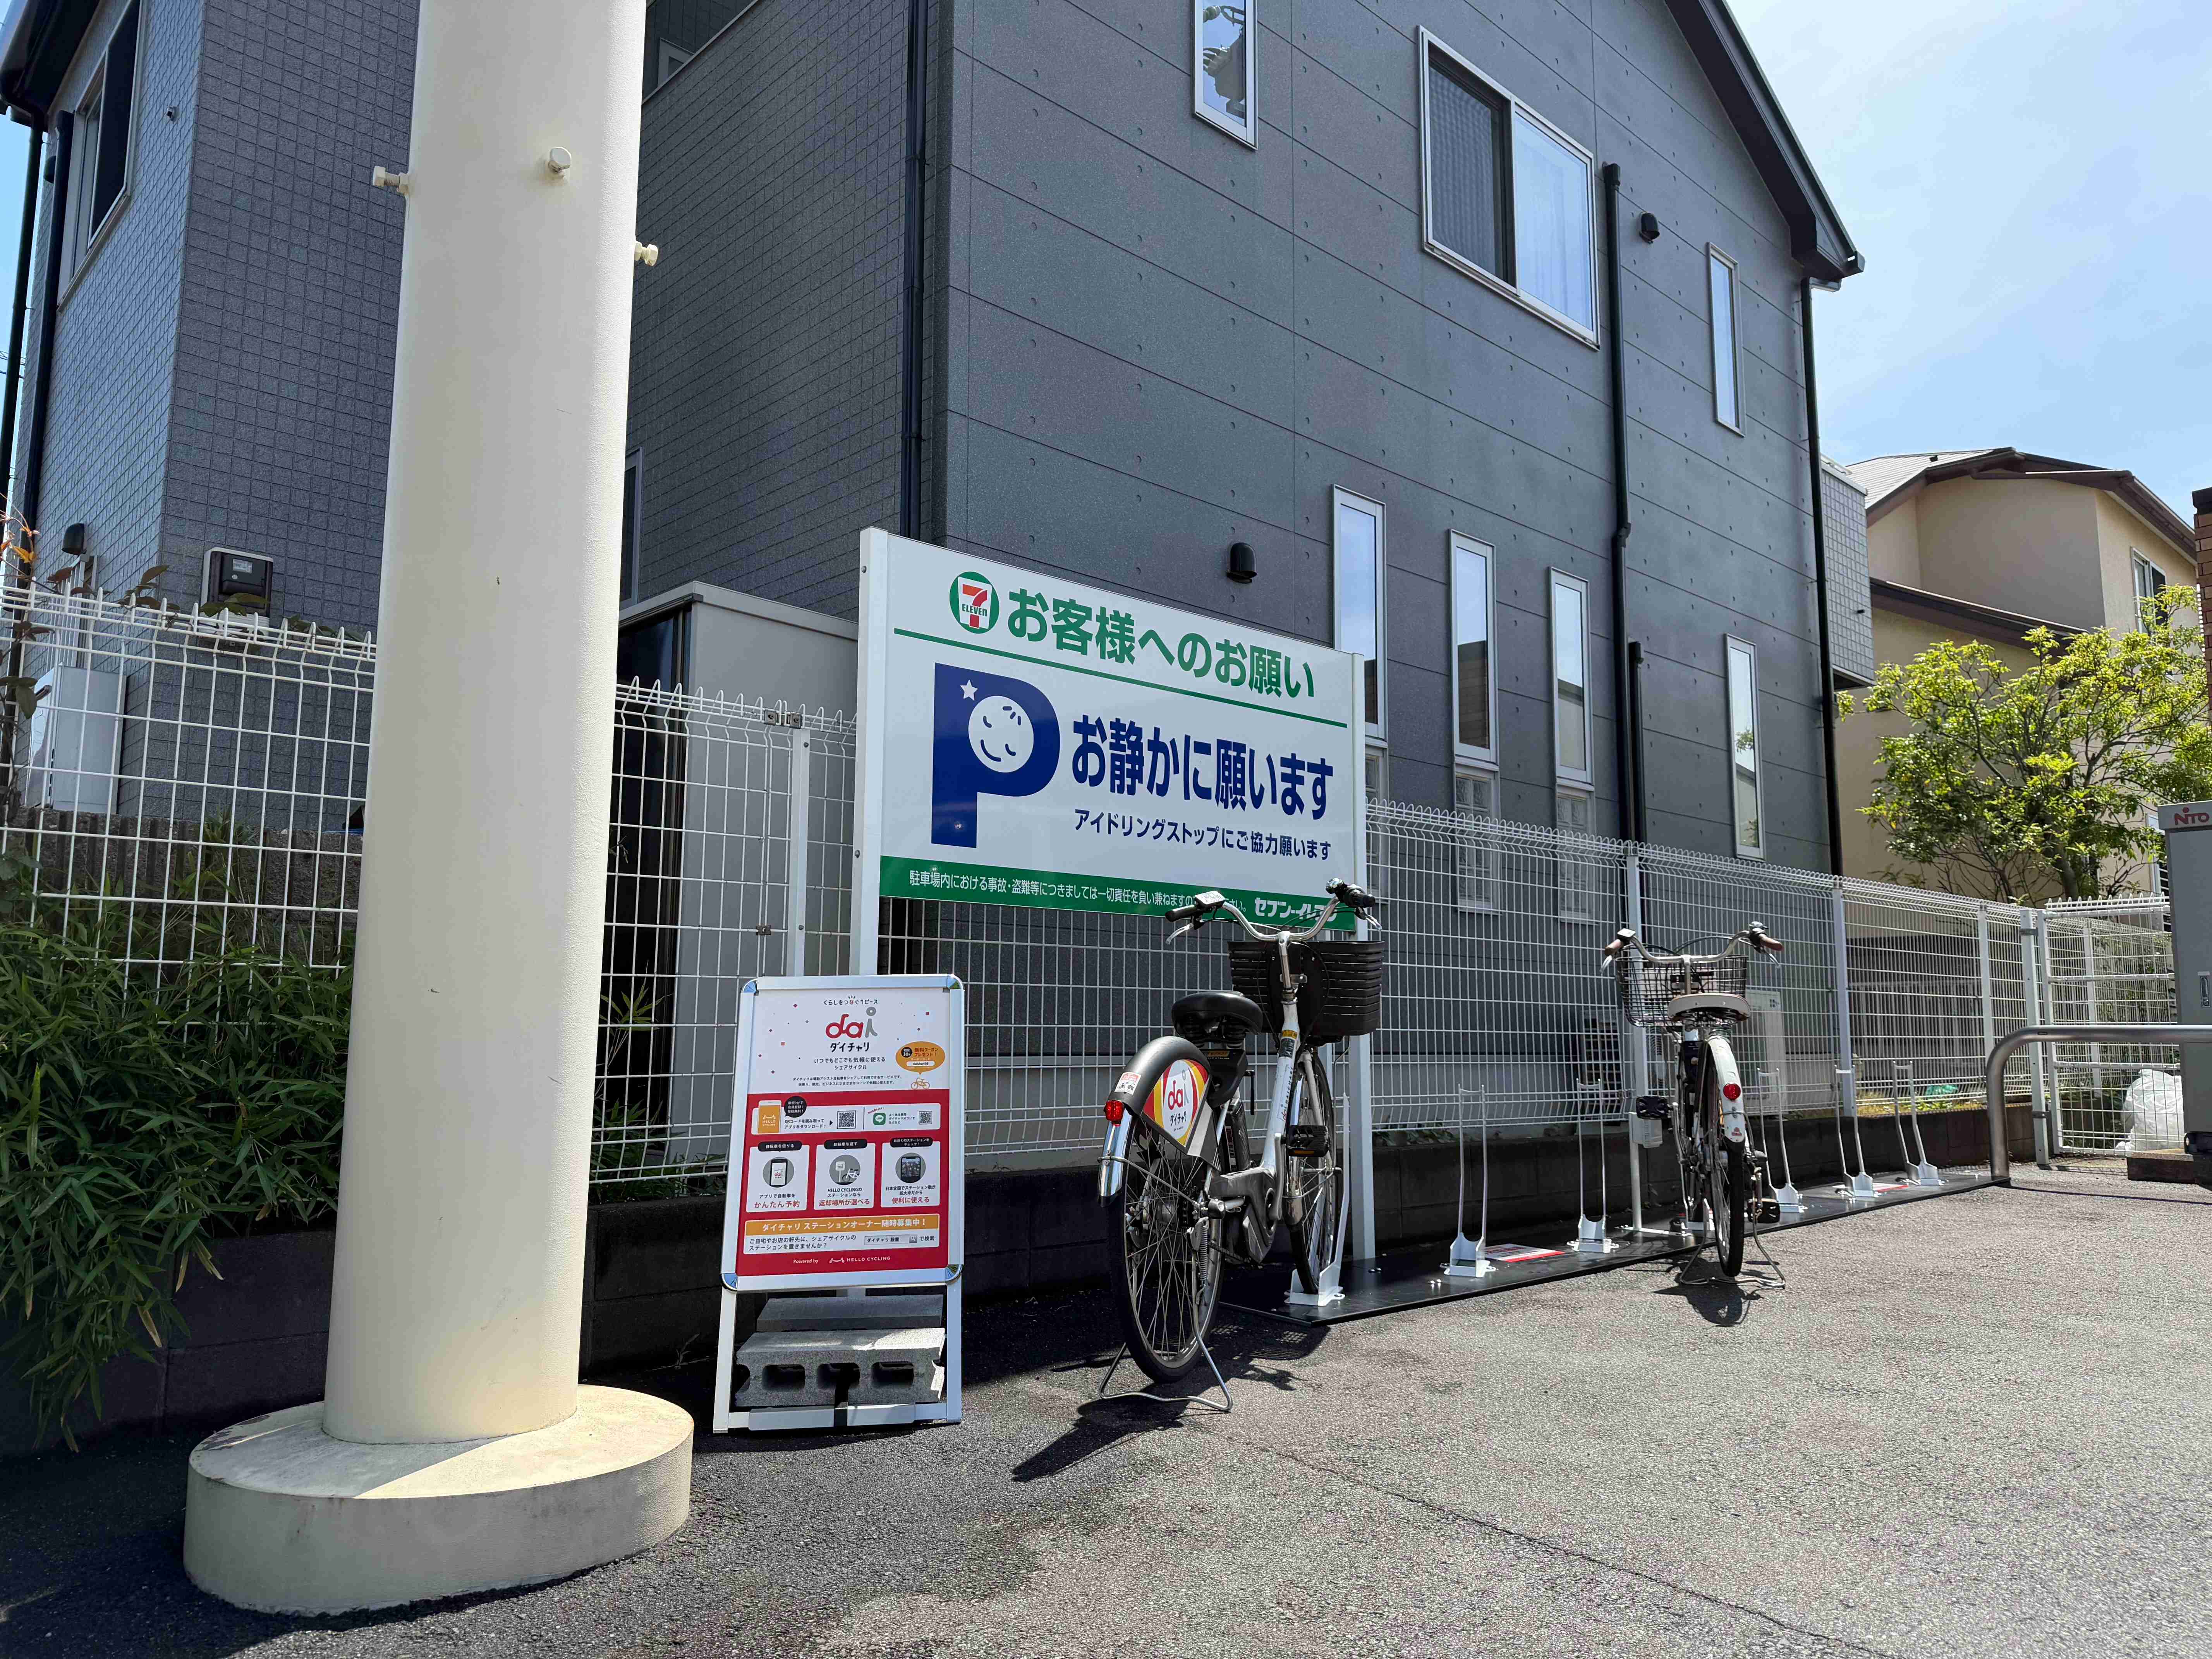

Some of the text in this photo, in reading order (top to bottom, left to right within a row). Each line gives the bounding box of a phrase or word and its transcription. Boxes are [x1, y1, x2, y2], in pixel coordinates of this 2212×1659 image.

[963, 584, 988, 628] 7
[1008, 588, 1314, 698] お客様へのお願い
[1072, 714, 1334, 821] お静かに願います
[1075, 809, 1331, 861] アイドリングストップにご協力願います
[825, 1006, 878, 1039] dai
[830, 1042, 869, 1053] ダイチャリ
[1168, 1069, 1189, 1110] dai
[1170, 1111, 1187, 1127] ダイチャリ
[754, 1200, 800, 1209] かんたん予約
[819, 1199, 870, 1207] 返却場所が選べる
[763, 1222, 800, 1231] ダイチャリ
[749, 1235, 856, 1244] ご自宅やお店の軒先に、シェアサイクルの
[749, 1243, 827, 1251] ステーションを置きませんか？
